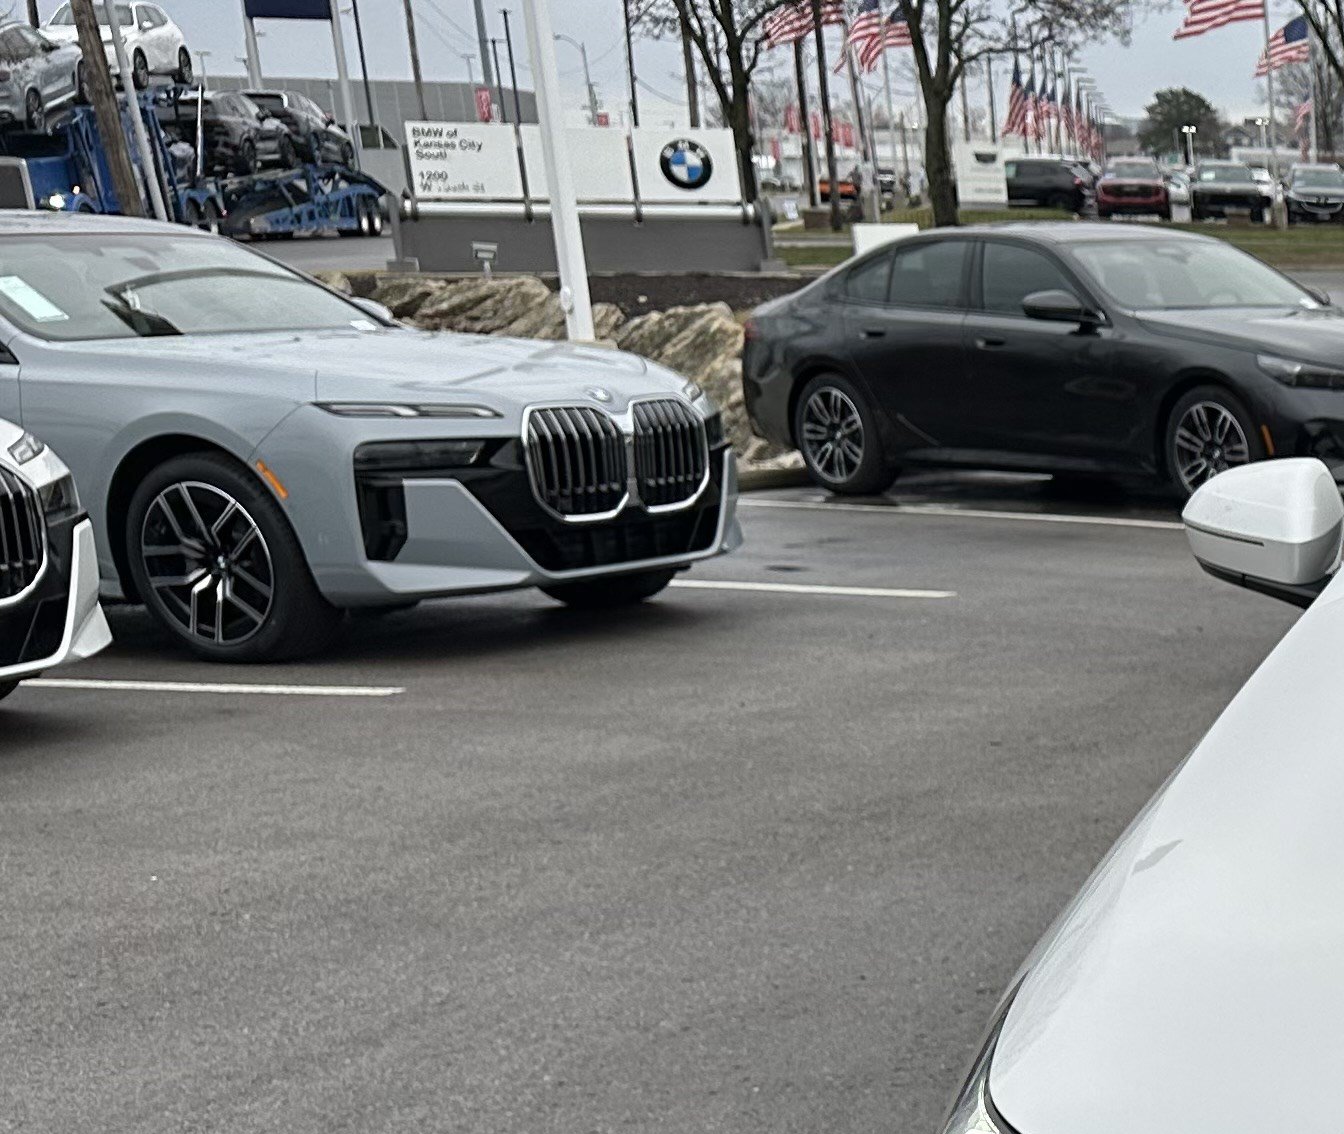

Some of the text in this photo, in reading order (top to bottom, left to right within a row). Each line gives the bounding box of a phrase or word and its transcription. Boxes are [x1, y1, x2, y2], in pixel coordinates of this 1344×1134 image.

[412, 127, 443, 138] BMW
[414, 139, 483, 152] Kansas City
[419, 170, 448, 181] 1200
